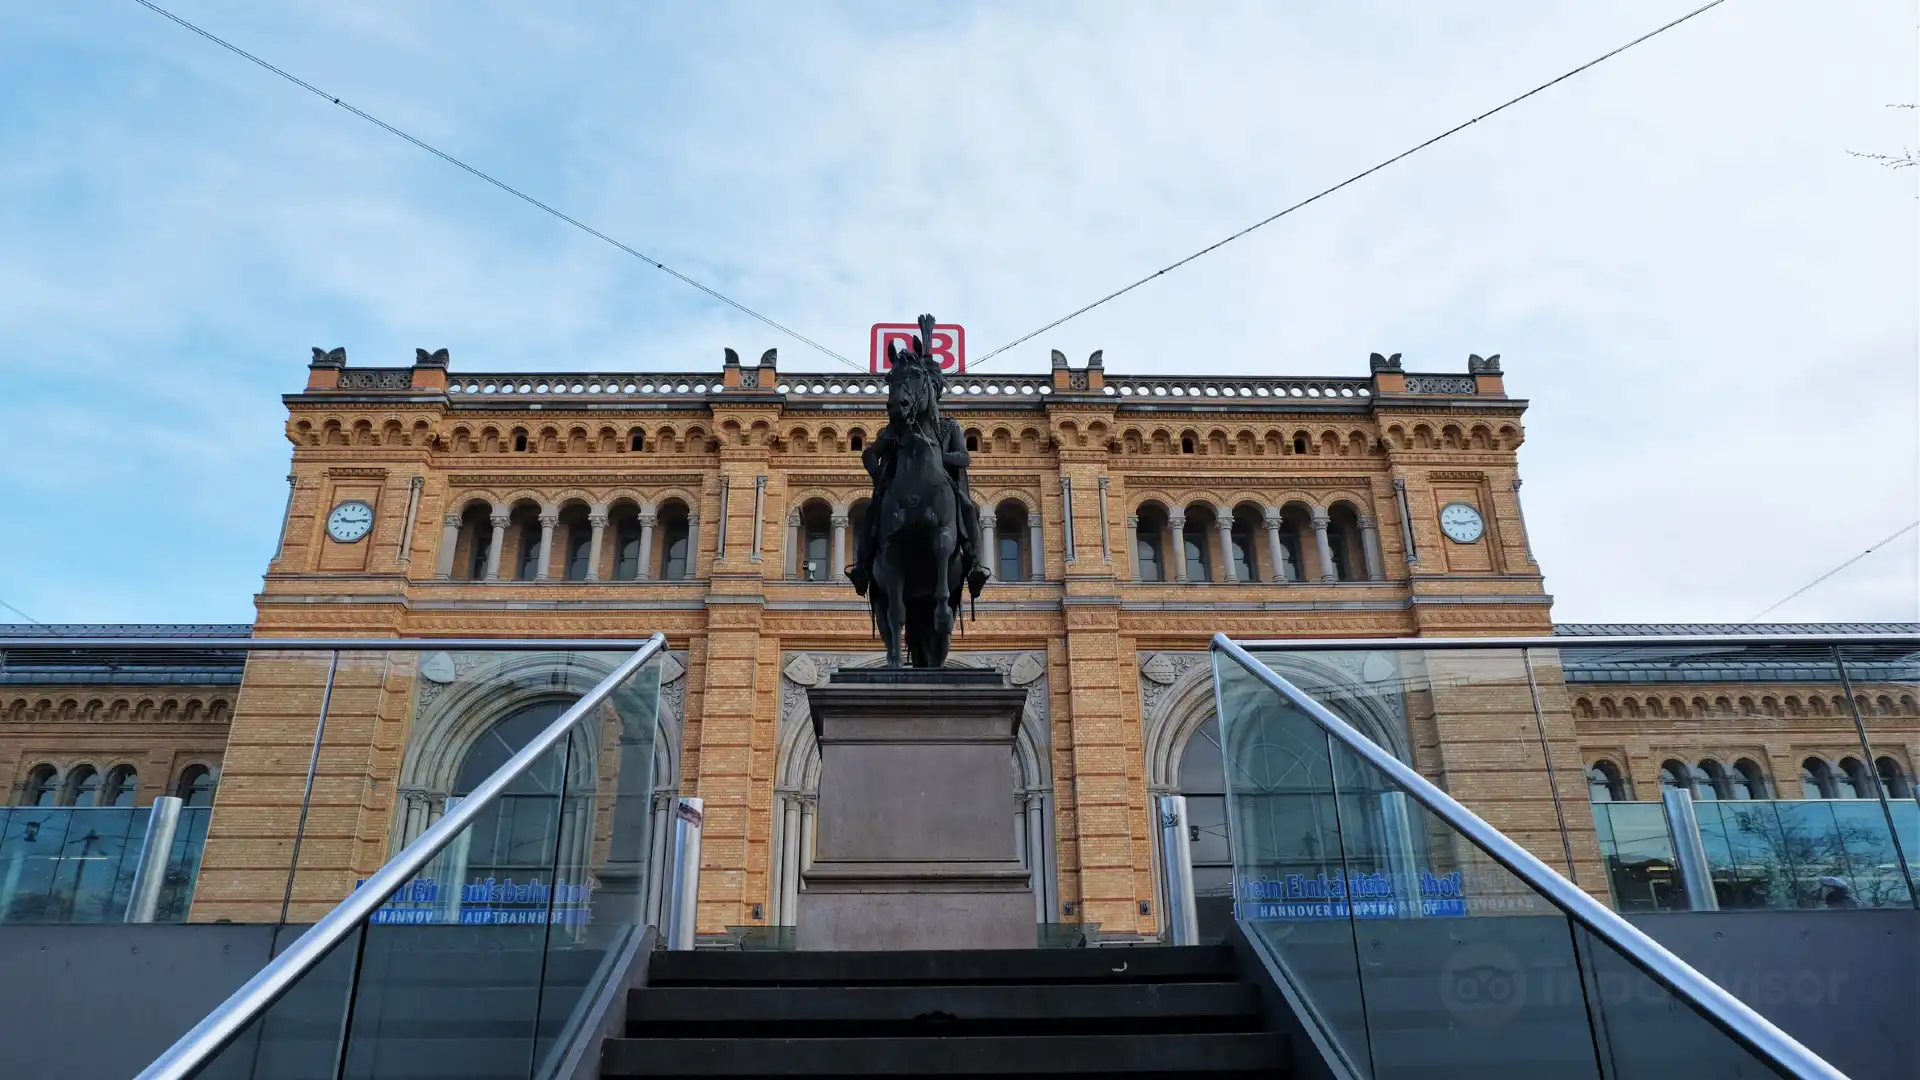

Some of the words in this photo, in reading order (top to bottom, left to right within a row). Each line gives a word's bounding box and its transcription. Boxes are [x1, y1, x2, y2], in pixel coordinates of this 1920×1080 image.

[883, 332, 955, 370] DB
[1260, 904, 1331, 917] HANNOVER
[1336, 903, 1438, 917] HAUPTBAOF
